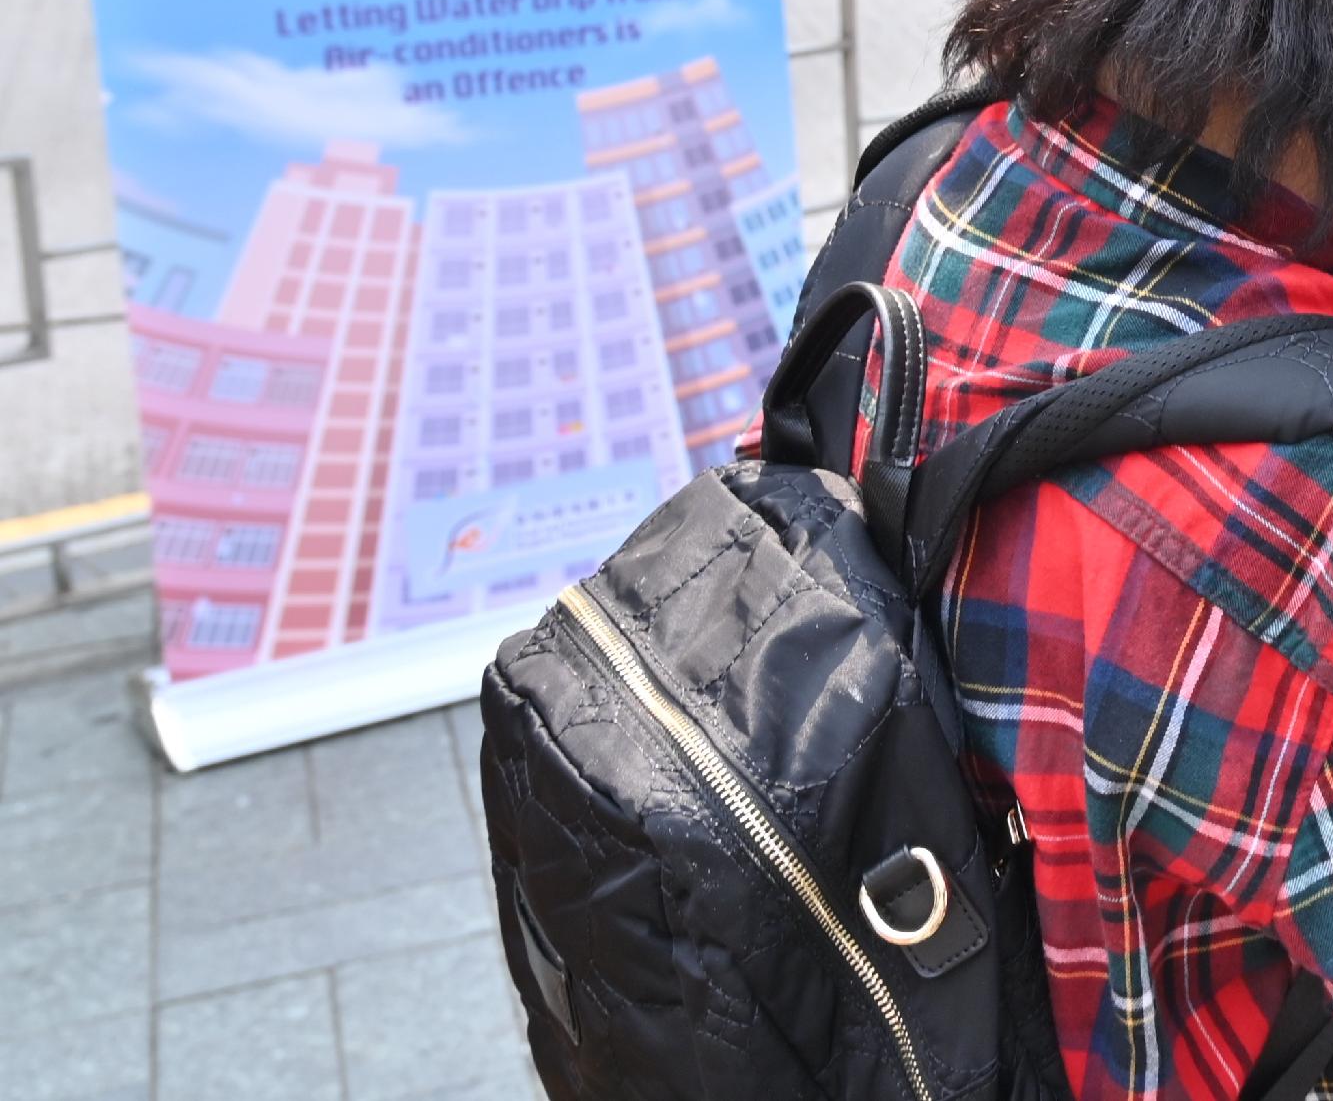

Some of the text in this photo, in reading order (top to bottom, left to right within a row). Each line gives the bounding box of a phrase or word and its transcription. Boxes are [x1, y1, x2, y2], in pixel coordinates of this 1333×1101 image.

[275, 2, 408, 38] Letting
[323, 18, 642, 72] Air-conditioners is
[402, 62, 587, 106] an Offence
